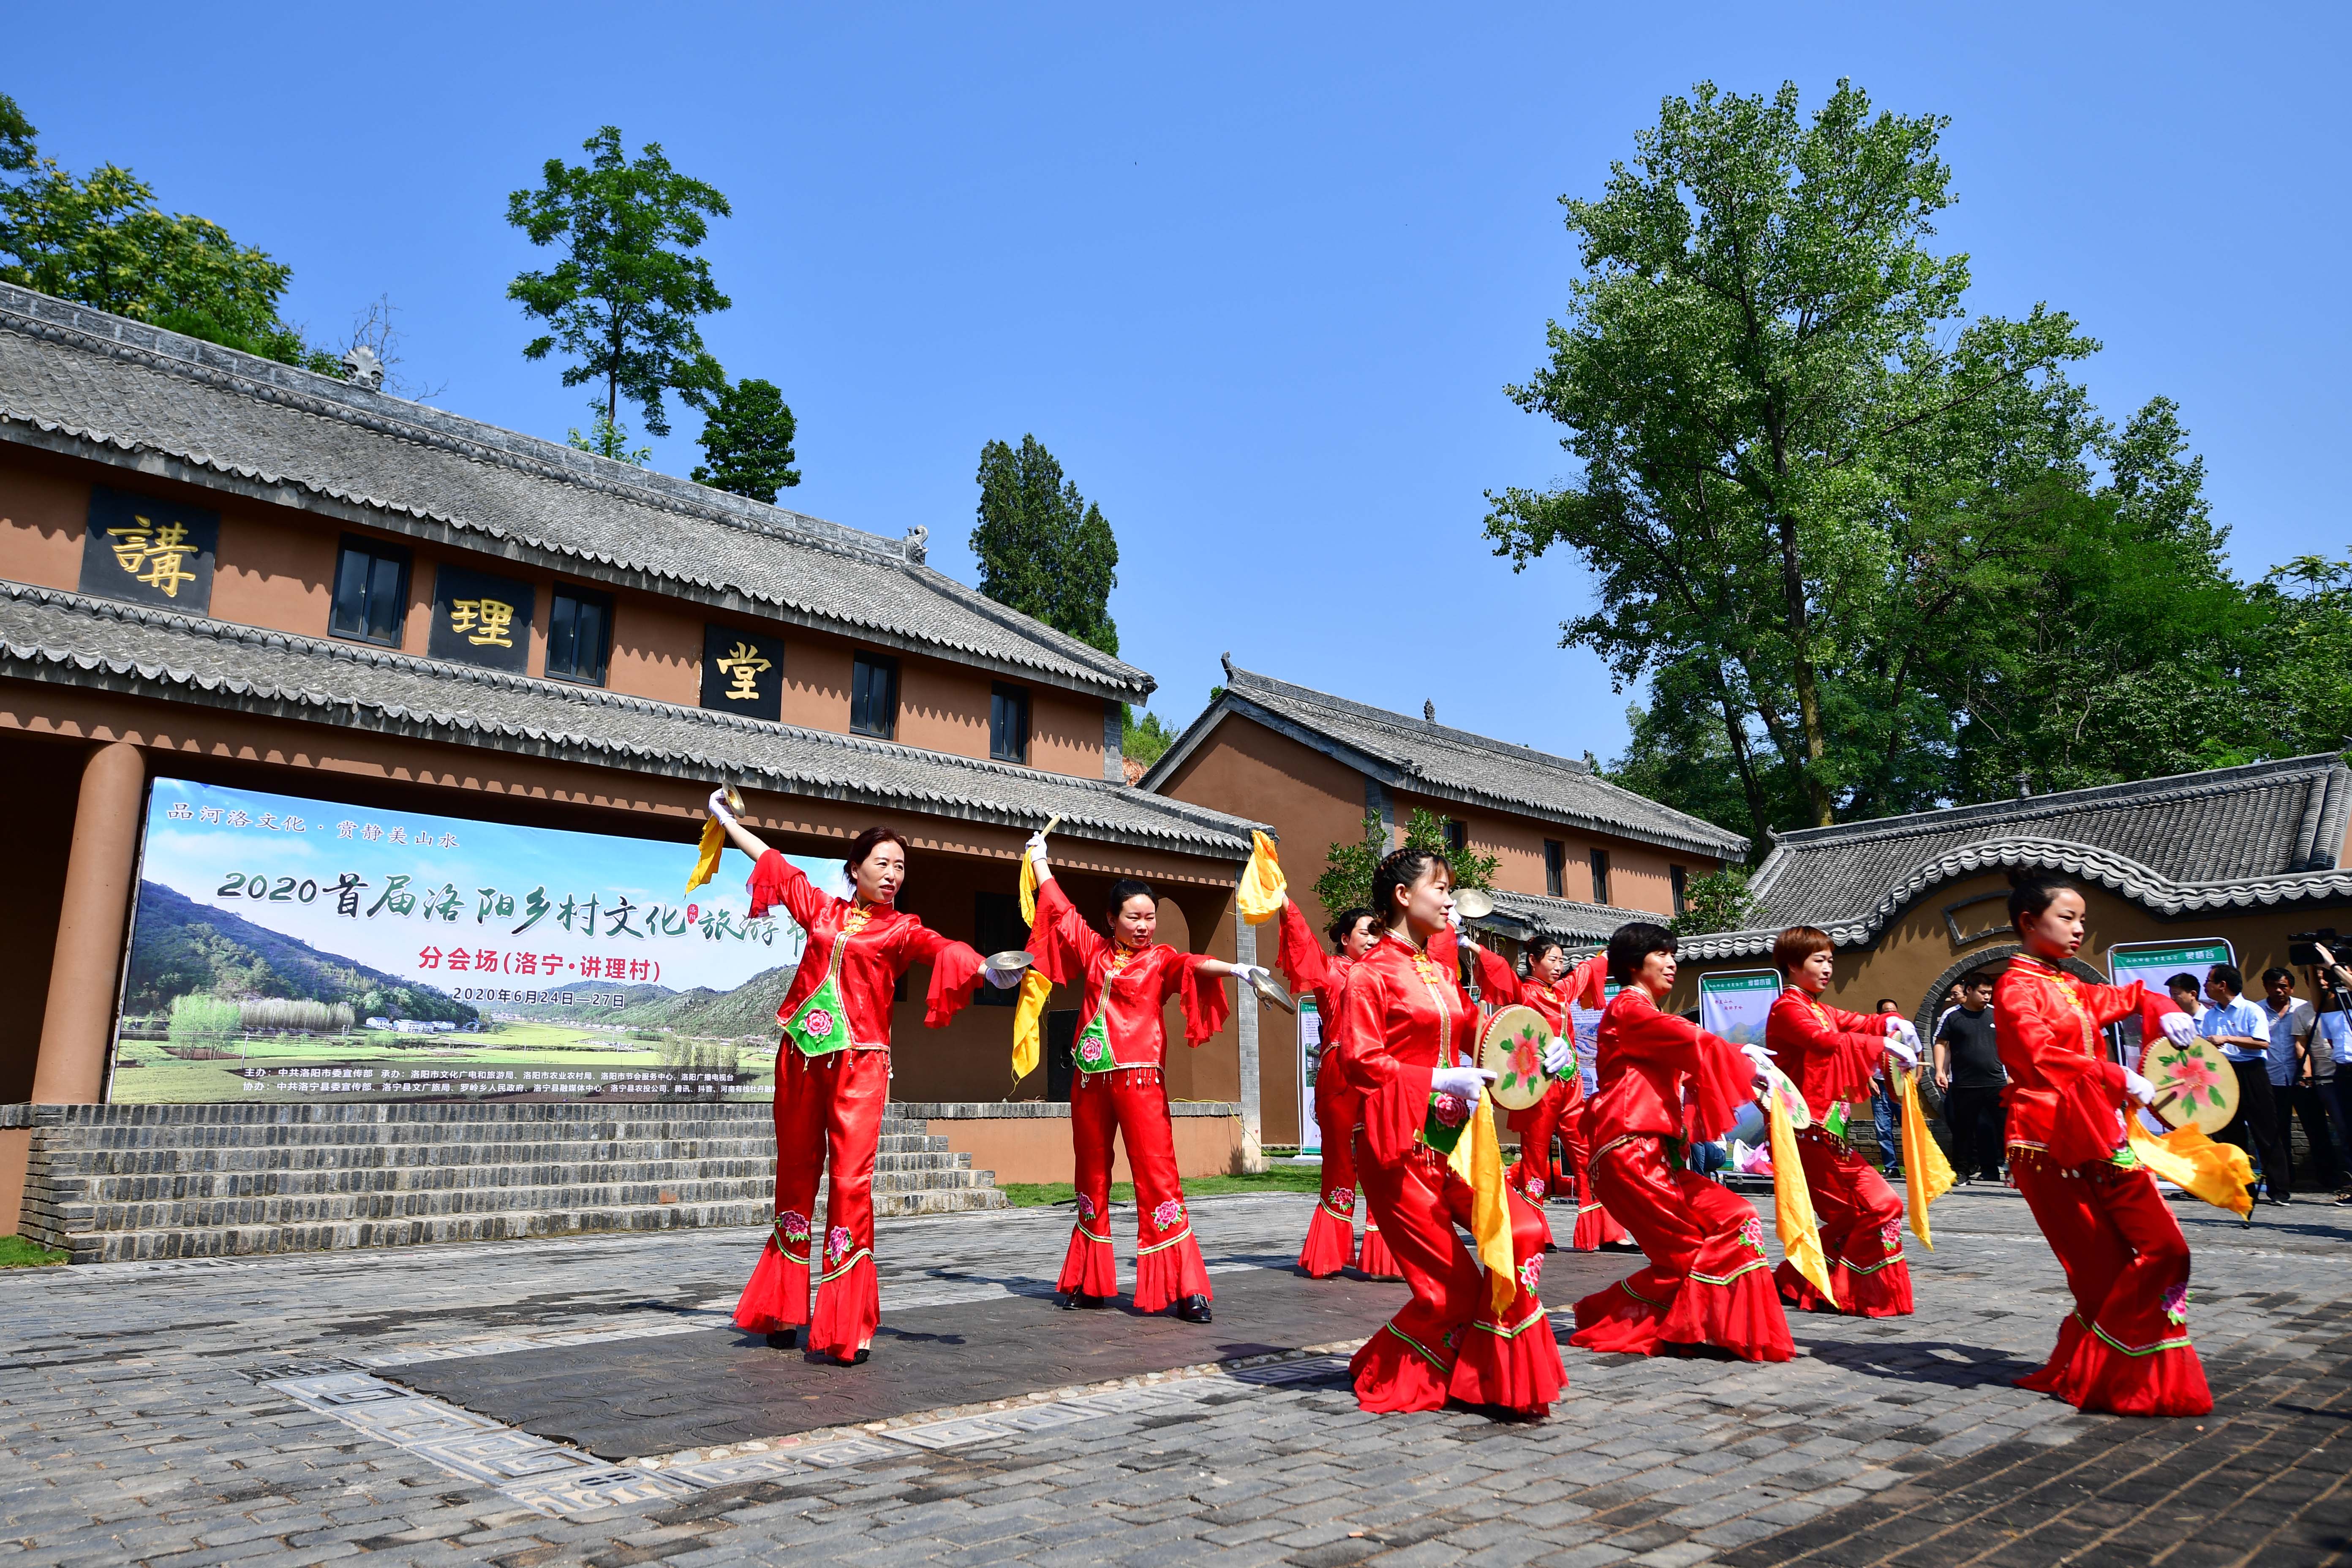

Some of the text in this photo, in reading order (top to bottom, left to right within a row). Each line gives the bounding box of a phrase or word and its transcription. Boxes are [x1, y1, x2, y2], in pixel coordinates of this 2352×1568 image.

[106, 515, 772, 700] 講 理 堂
[689, 906, 697, 920] 洛阳
